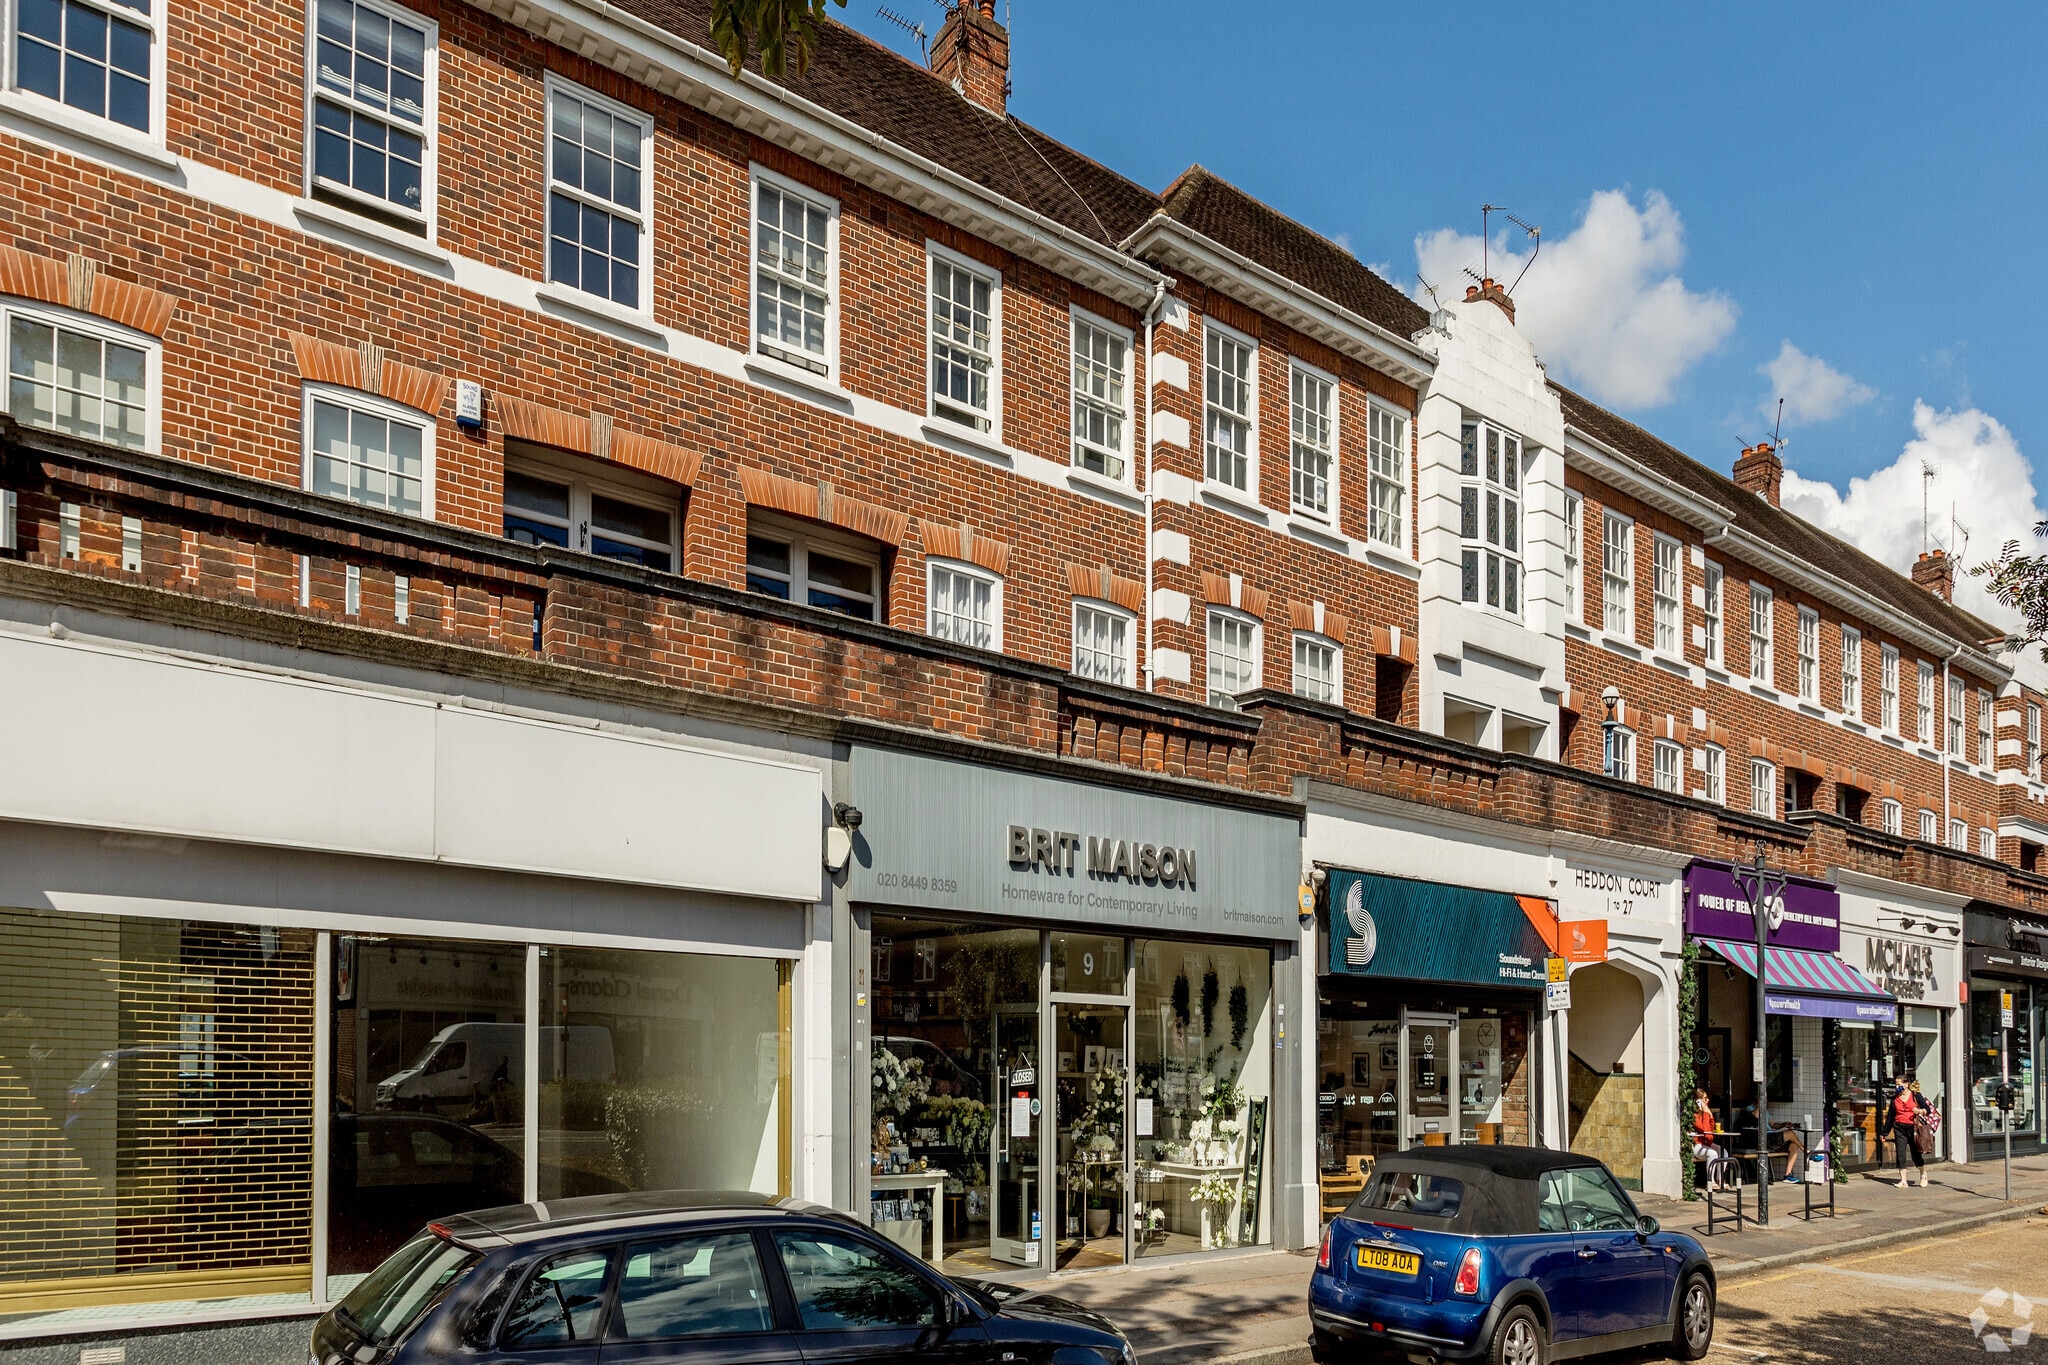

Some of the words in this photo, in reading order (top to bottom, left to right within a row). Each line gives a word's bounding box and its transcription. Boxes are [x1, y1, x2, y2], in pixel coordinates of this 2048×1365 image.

[1006, 825, 1080, 868] BRIT
[1086, 836, 1196, 882] MAISON
[877, 872, 898, 887] 020
[901, 874, 928, 890] 8449
[931, 878, 957, 893] 8359
[1575, 869, 1622, 893] HEDDON
[1628, 877, 1661, 899] COURT
[1002, 883, 1065, 904] Homeware
[1068, 890, 1084, 905] for
[1087, 892, 1164, 917] Contemporary
[1167, 901, 1198, 920] Living
[1622, 899, 1634, 915] 27
[1698, 894, 1725, 911] POWER
[1726, 898, 1735, 912] OF
[1223, 909, 1284, 926] britmaison.com
[1083, 952, 1094, 976] 9
[1500, 953, 1532, 967] Soundstage
[1866, 937, 1933, 981] MICHAEL'S
[2020, 955, 2037, 968] Interior
[1500, 967, 1513, 977] Hi-Fi
[1513, 969, 1517, 977] &
[1518, 969, 1532, 979] Home
[1548, 986, 1552, 996] P
[1012, 1071, 1033, 1083] CLOSED
[1362, 1249, 1389, 1269] LT08
[1392, 1254, 1413, 1271] AOA
